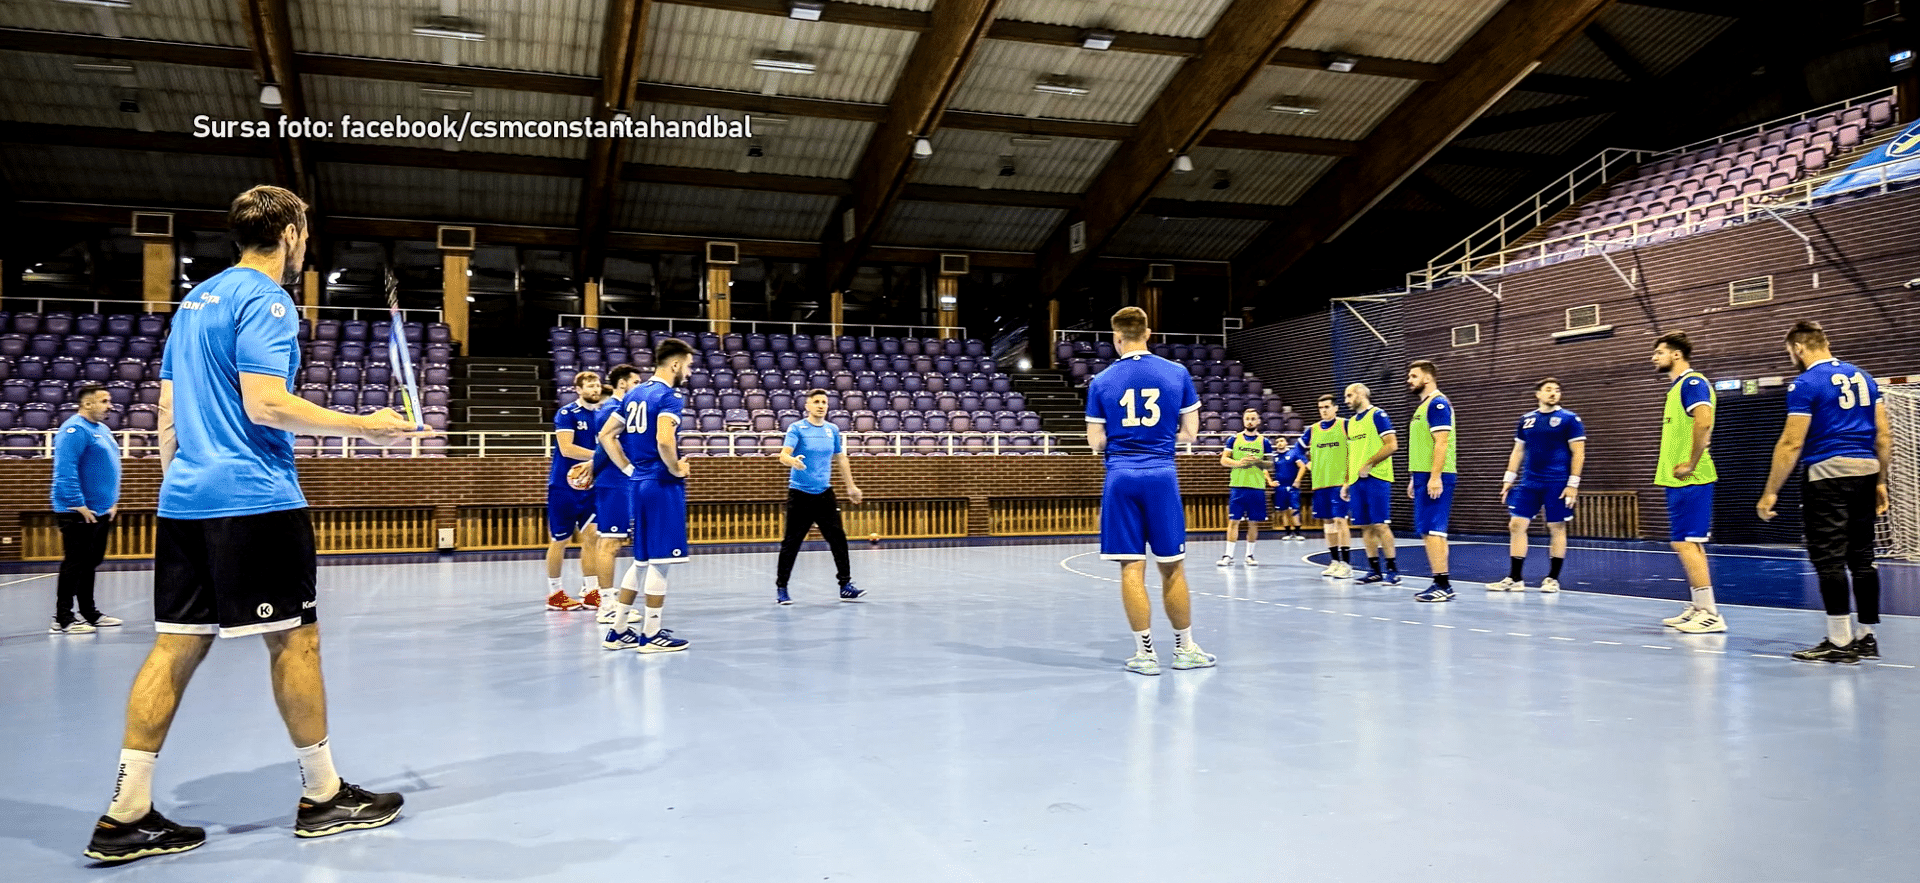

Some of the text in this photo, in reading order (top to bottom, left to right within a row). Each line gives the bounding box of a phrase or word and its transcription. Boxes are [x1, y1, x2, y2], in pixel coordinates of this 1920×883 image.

[1119, 388, 1160, 427] 13
[1830, 371, 1870, 410] 31
[576, 420, 588, 431] 34
[626, 400, 647, 434] 20
[1522, 417, 1536, 429] 22
